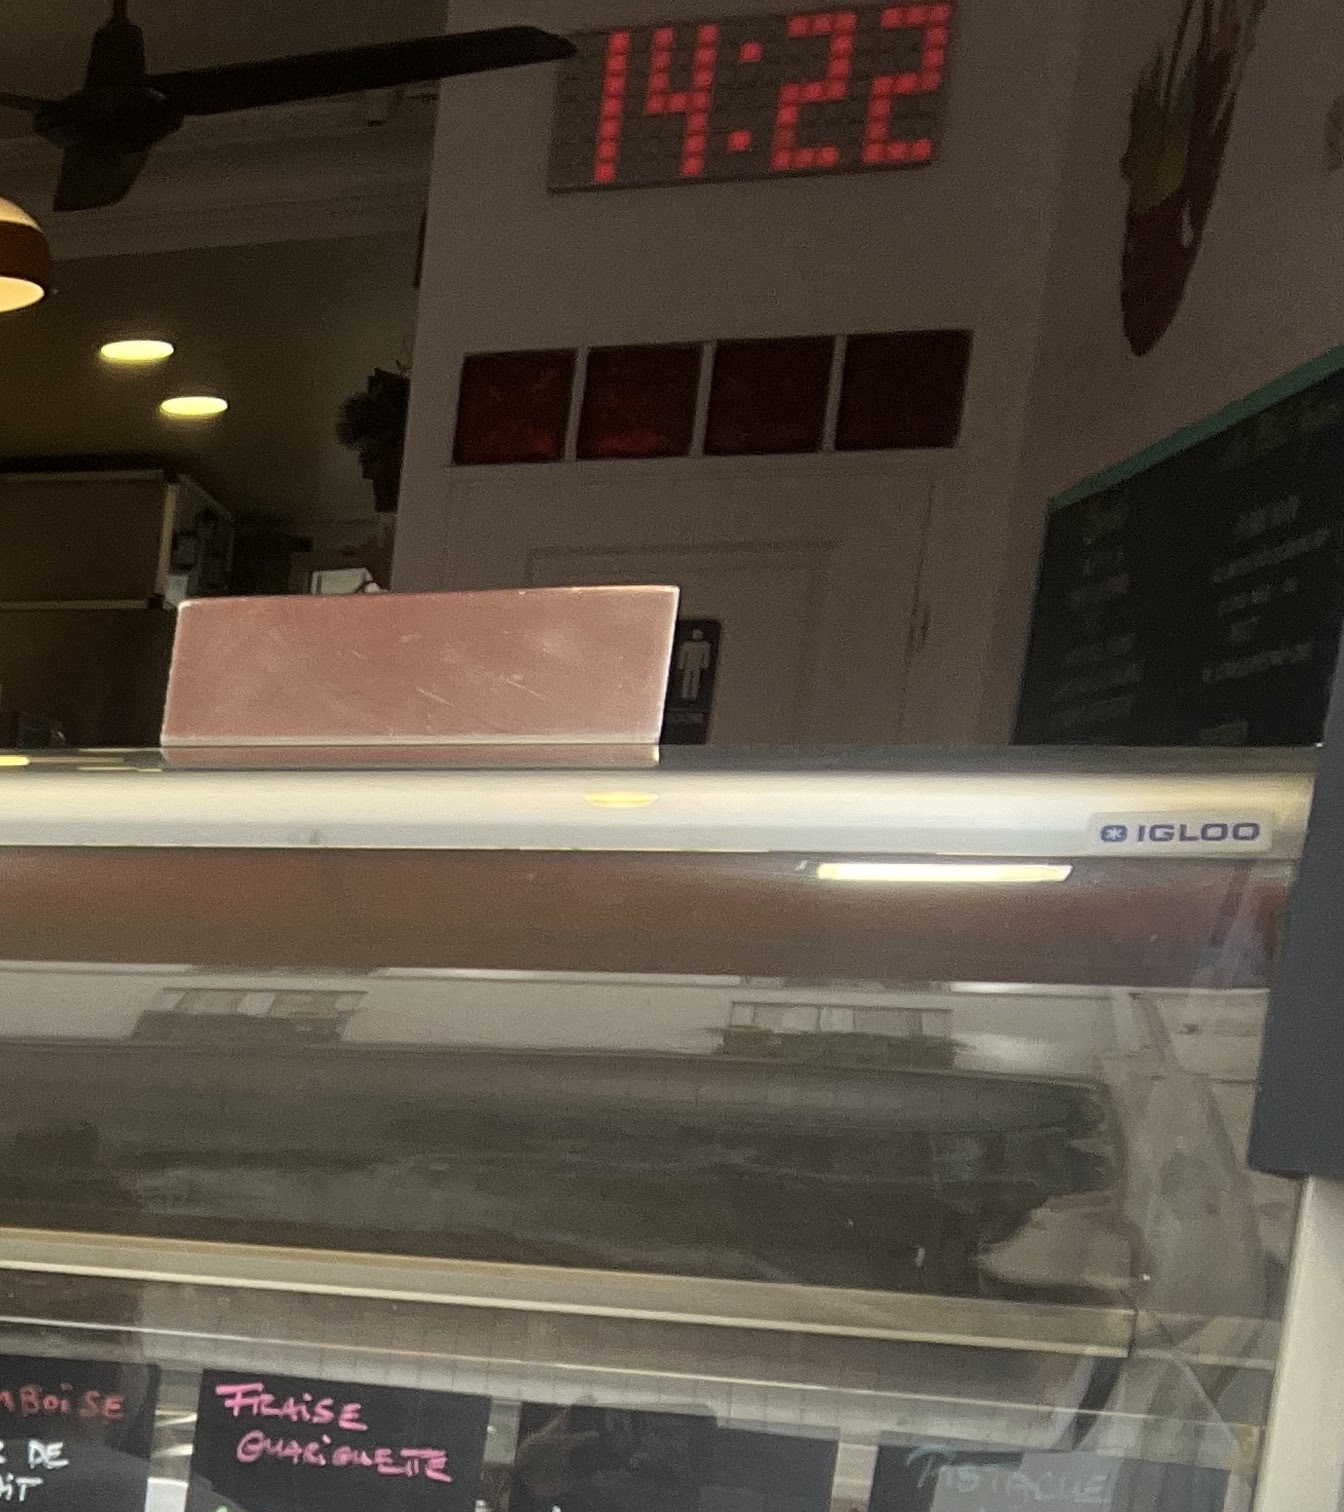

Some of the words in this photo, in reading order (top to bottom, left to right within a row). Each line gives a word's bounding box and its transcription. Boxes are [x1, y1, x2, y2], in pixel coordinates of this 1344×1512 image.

[592, 2, 957, 184] 14:22
[1137, 822, 1261, 843] IGLOO
[27, 1439, 70, 1470] DE
